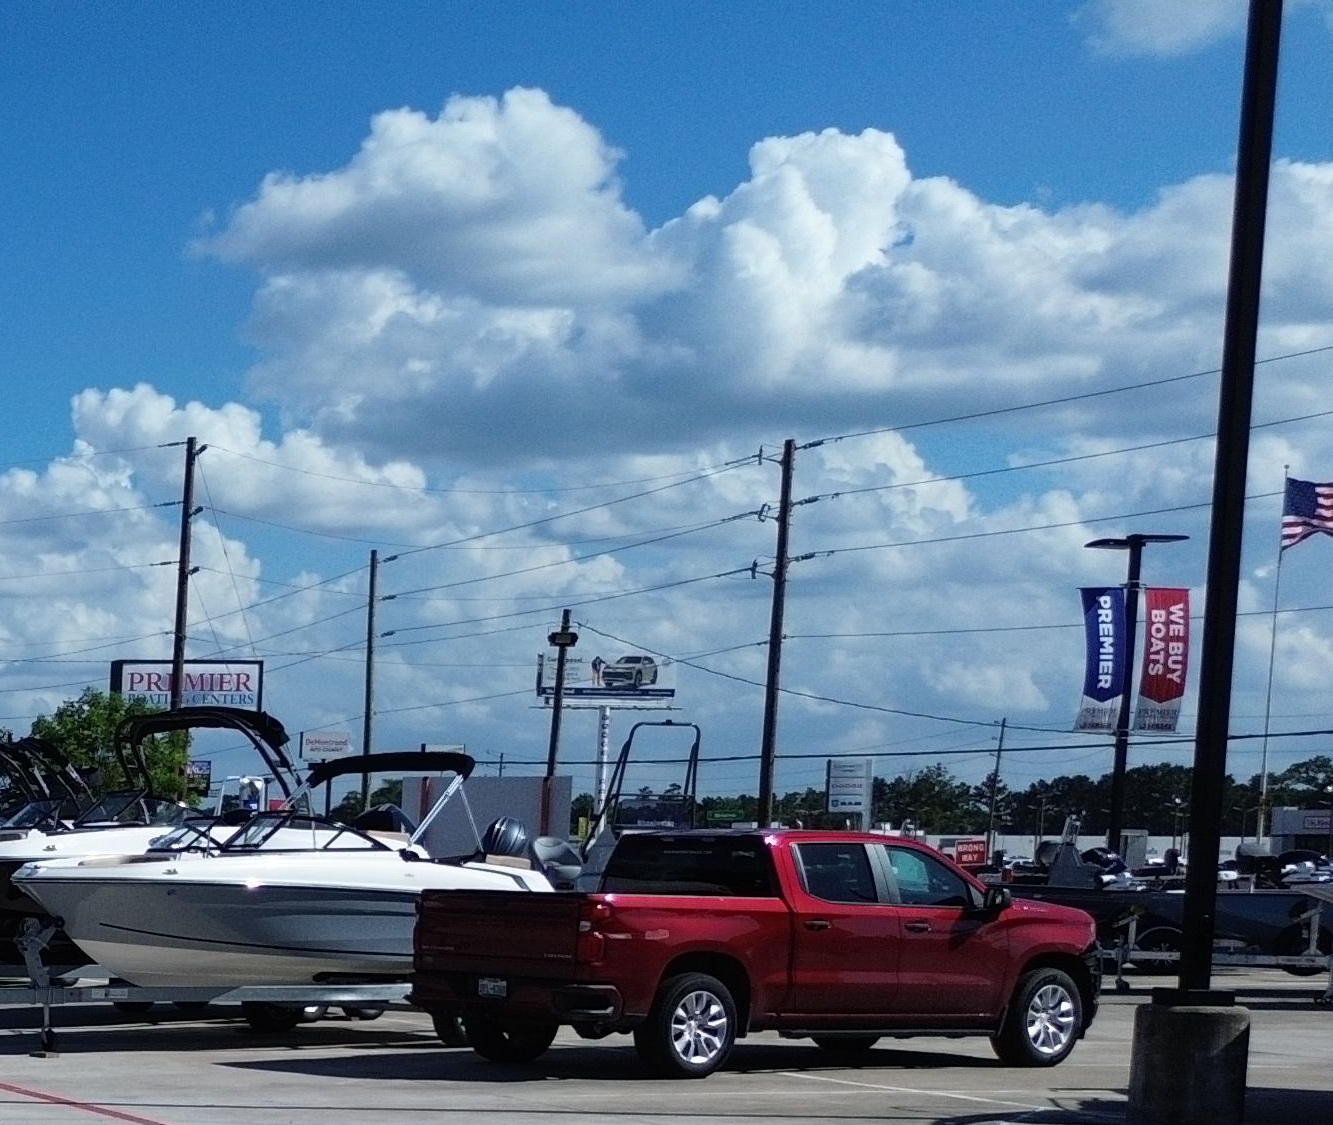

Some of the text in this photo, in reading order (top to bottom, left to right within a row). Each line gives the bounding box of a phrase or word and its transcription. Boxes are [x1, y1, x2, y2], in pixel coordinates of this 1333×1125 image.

[1096, 595, 1114, 689] PREMIER
[1148, 609, 1166, 676] BOATS
[1166, 603, 1185, 684] WE BUY
[192, 694, 254, 705] CENTERS
